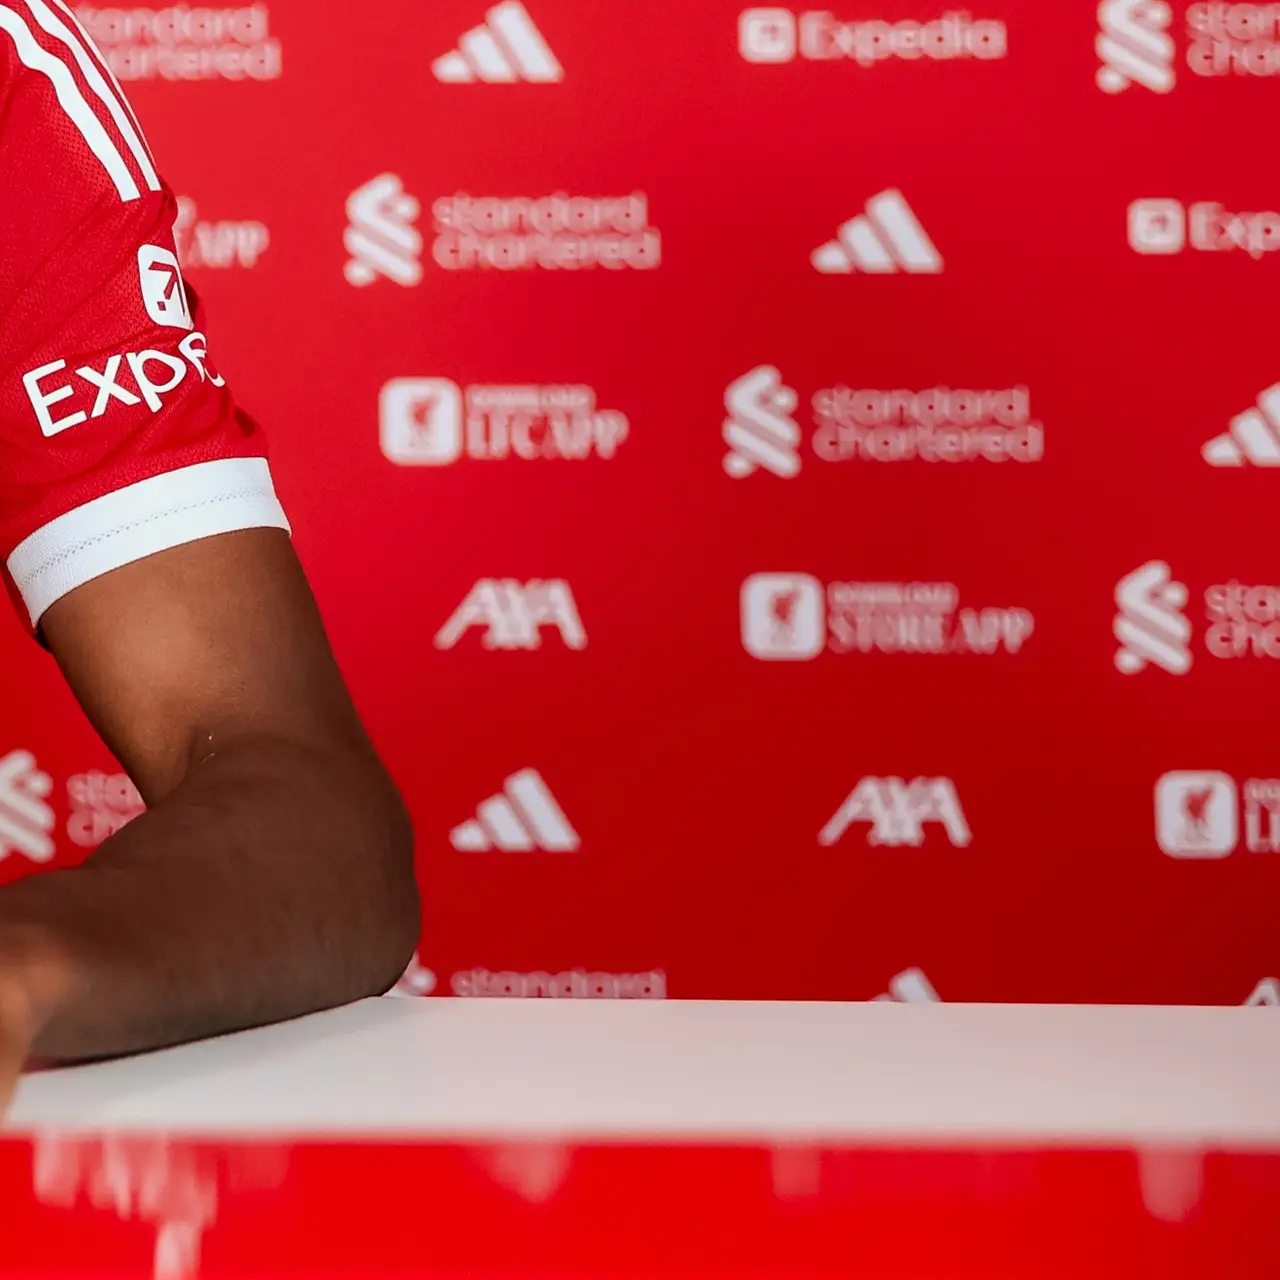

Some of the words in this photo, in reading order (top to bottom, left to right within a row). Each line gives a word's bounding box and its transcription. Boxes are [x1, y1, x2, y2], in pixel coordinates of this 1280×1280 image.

[797, 10, 1007, 68] Expedia
[435, 578, 587, 650] AXA
[819, 776, 971, 847] AXA
